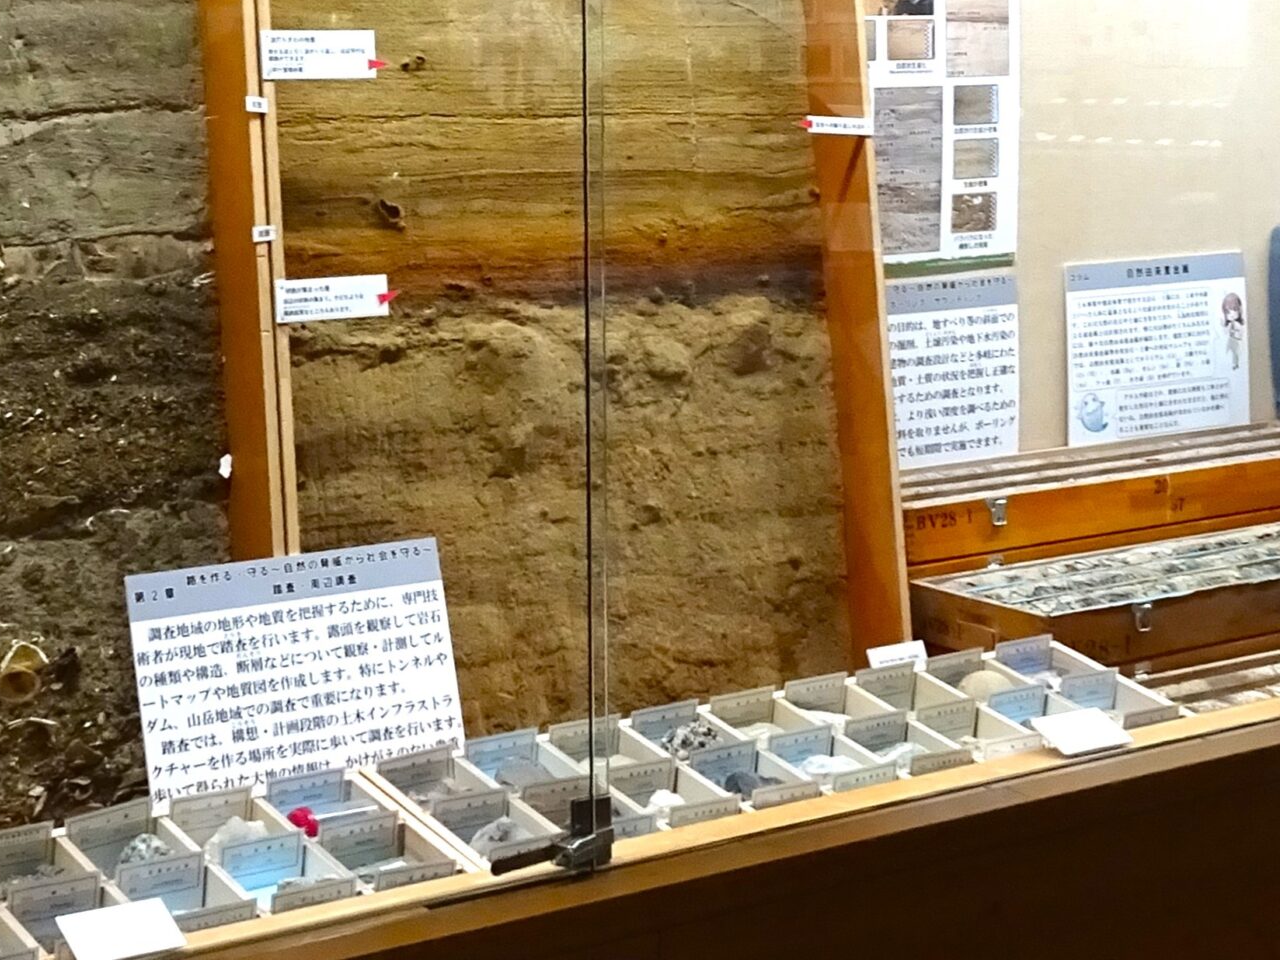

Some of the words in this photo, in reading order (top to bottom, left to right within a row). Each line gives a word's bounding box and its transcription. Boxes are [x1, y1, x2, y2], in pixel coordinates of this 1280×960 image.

[135, 609, 441, 668] 術者が現地で踏査を行います。露頭を観察して岩石
[147, 587, 439, 643] 調査地域の地形や地質を把握するために、専門技
[138, 629, 444, 690] の種類や構造、断層などについて観察・計測してル
[141, 650, 448, 713] ートマップや地質図を作成します。特にトンネルや
[144, 678, 406, 734] ダム、山岳地域での調査で重要になります。
[160, 693, 453, 757] 踏査では、構想・計画段階の土木インフラストラ
[150, 712, 461, 781] クチャーを作る場所を実際に歩いて調査を行います。
